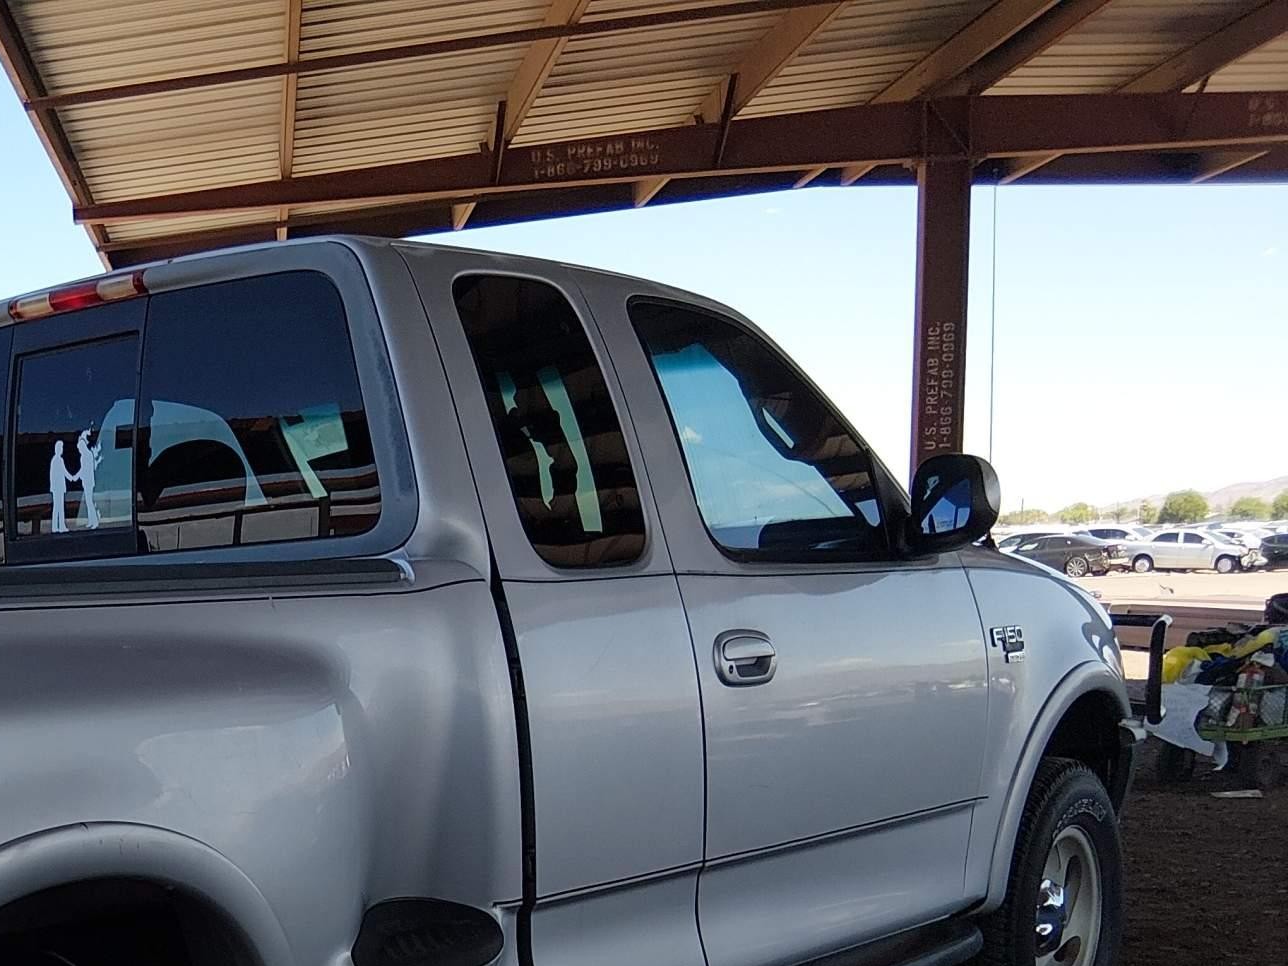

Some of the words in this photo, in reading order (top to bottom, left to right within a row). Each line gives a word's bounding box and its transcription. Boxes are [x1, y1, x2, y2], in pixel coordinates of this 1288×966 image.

[568, 142, 624, 160] PREFAB
[927, 321, 941, 350] INC.
[925, 358, 939, 414] PREFAB
[939, 322, 955, 448] 1-866-799-0969
[924, 421, 937, 450] U.S.
